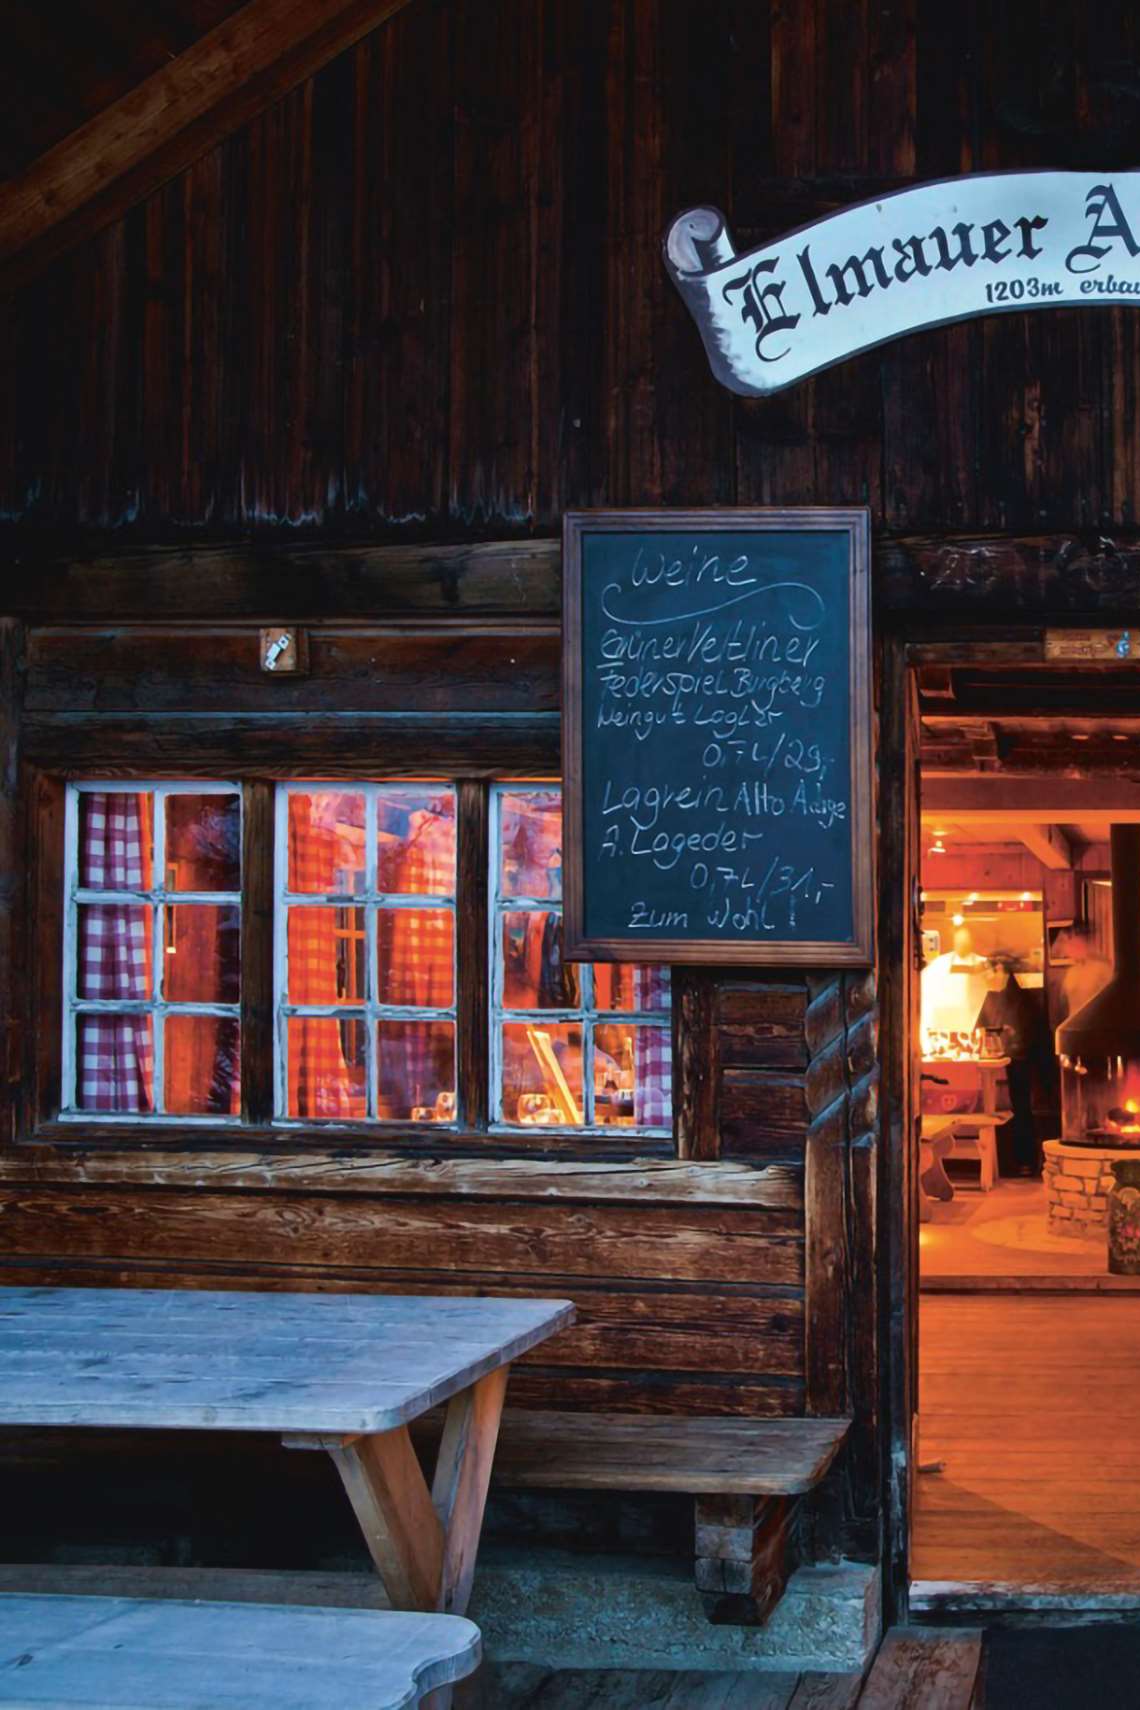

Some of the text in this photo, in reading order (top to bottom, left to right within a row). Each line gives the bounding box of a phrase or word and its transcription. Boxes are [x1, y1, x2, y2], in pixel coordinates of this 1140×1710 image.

[722, 215, 1049, 362] Elmauer
[985, 277, 1064, 303] 1203m
[631, 545, 757, 587] Weine
[733, 781, 785, 816] Alto
[628, 901, 689, 929] Zum
